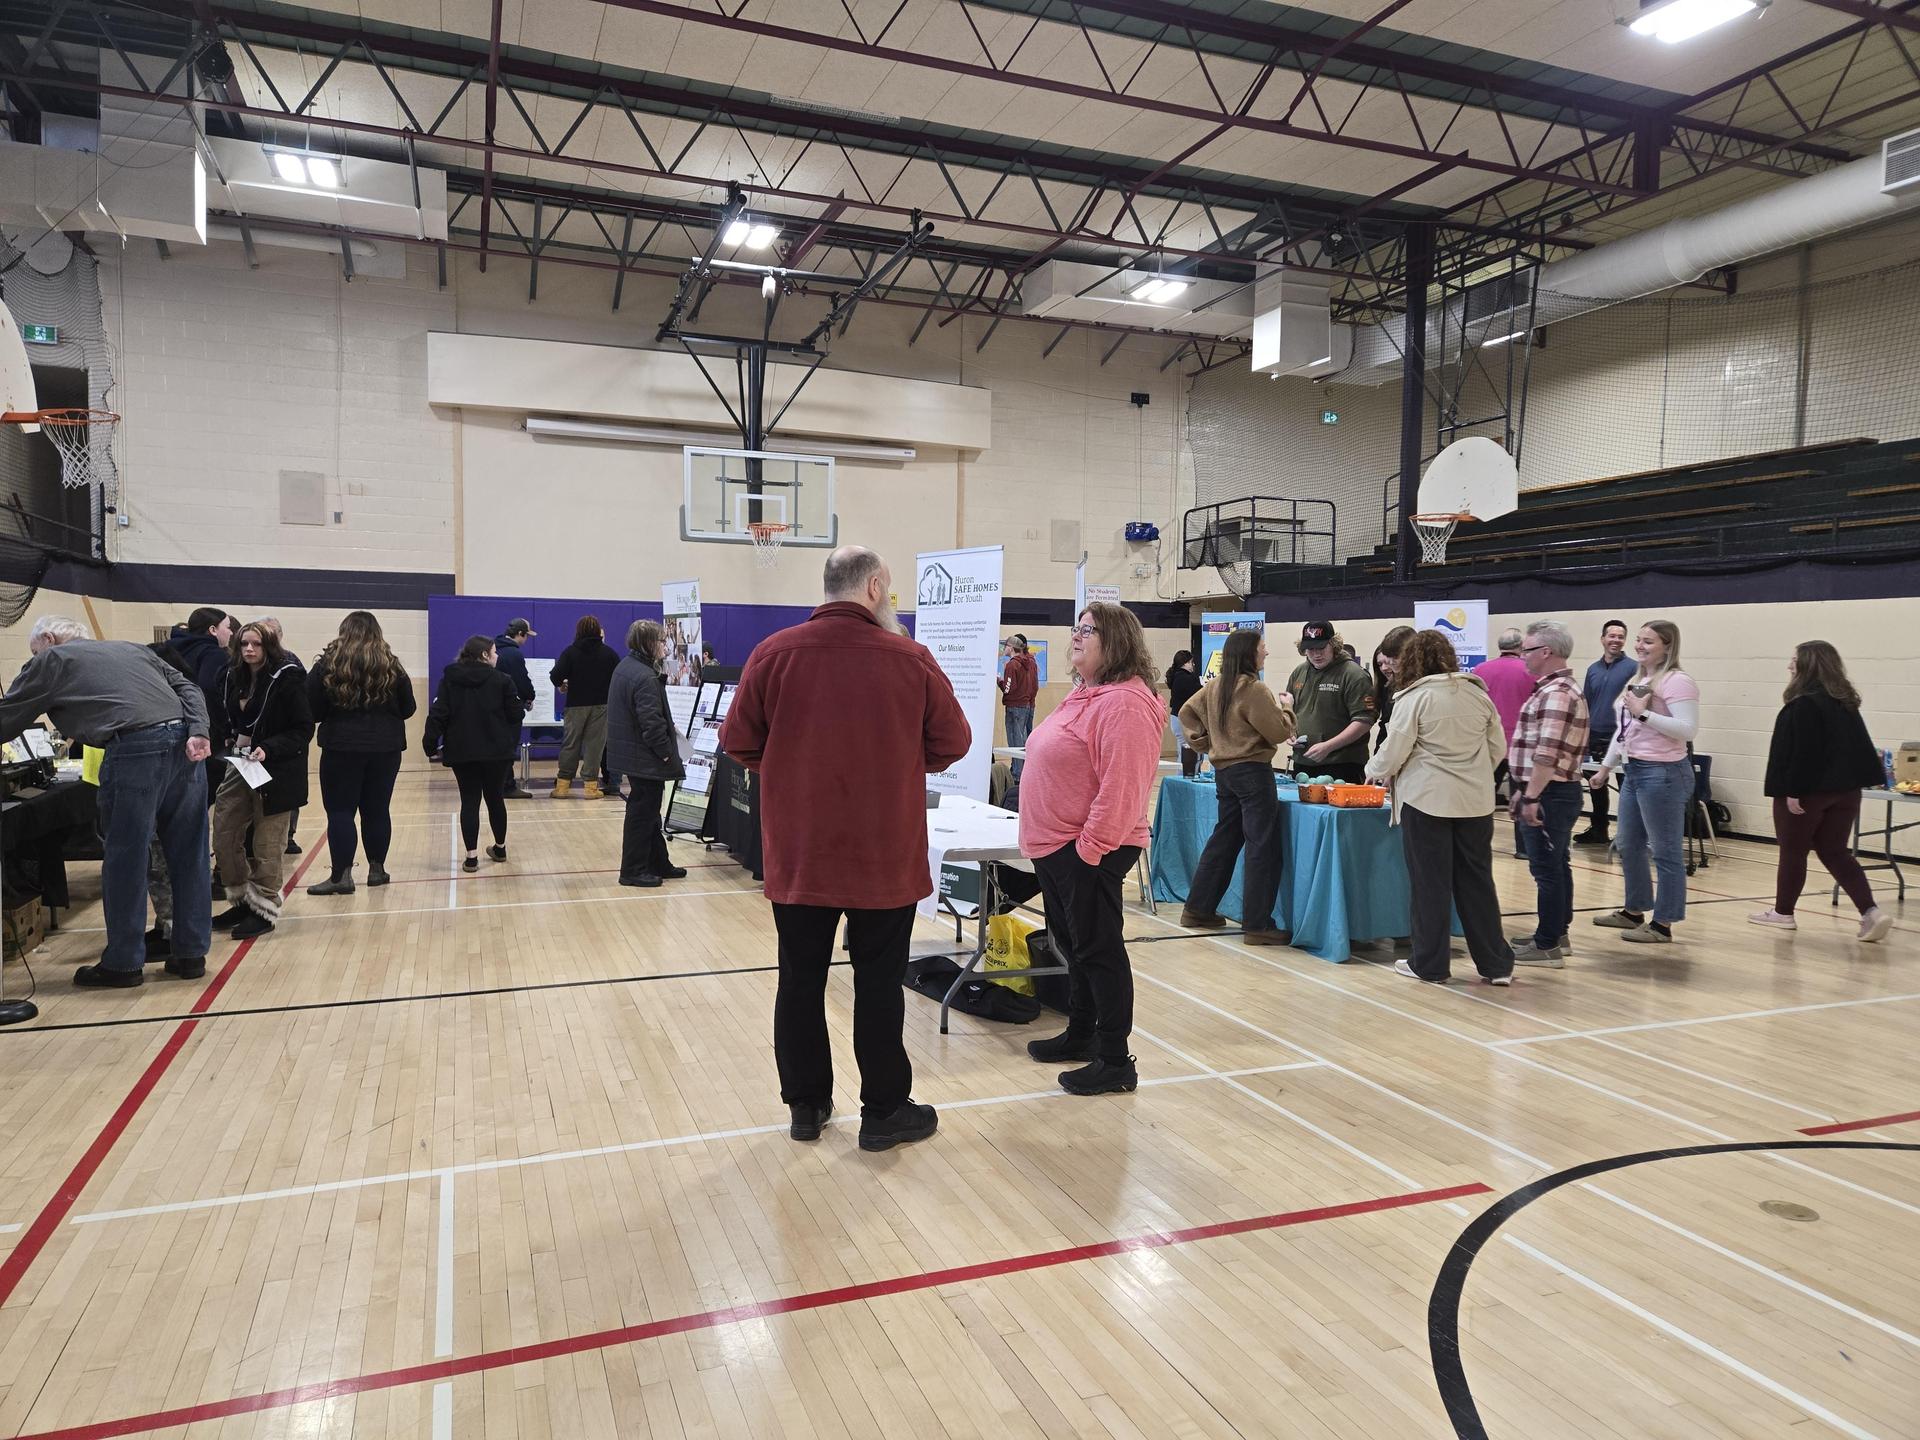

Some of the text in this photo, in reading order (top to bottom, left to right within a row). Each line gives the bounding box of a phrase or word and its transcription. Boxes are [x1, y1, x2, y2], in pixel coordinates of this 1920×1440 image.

[955, 576, 974, 584] Huron
[954, 583, 999, 593] SAFE HOMES
[954, 593, 983, 603] For Youth
[1447, 632, 1466, 641] RON
[938, 644, 965, 652] Our Mission
[1457, 655, 1469, 664] OU
[941, 871, 960, 882] rmation
